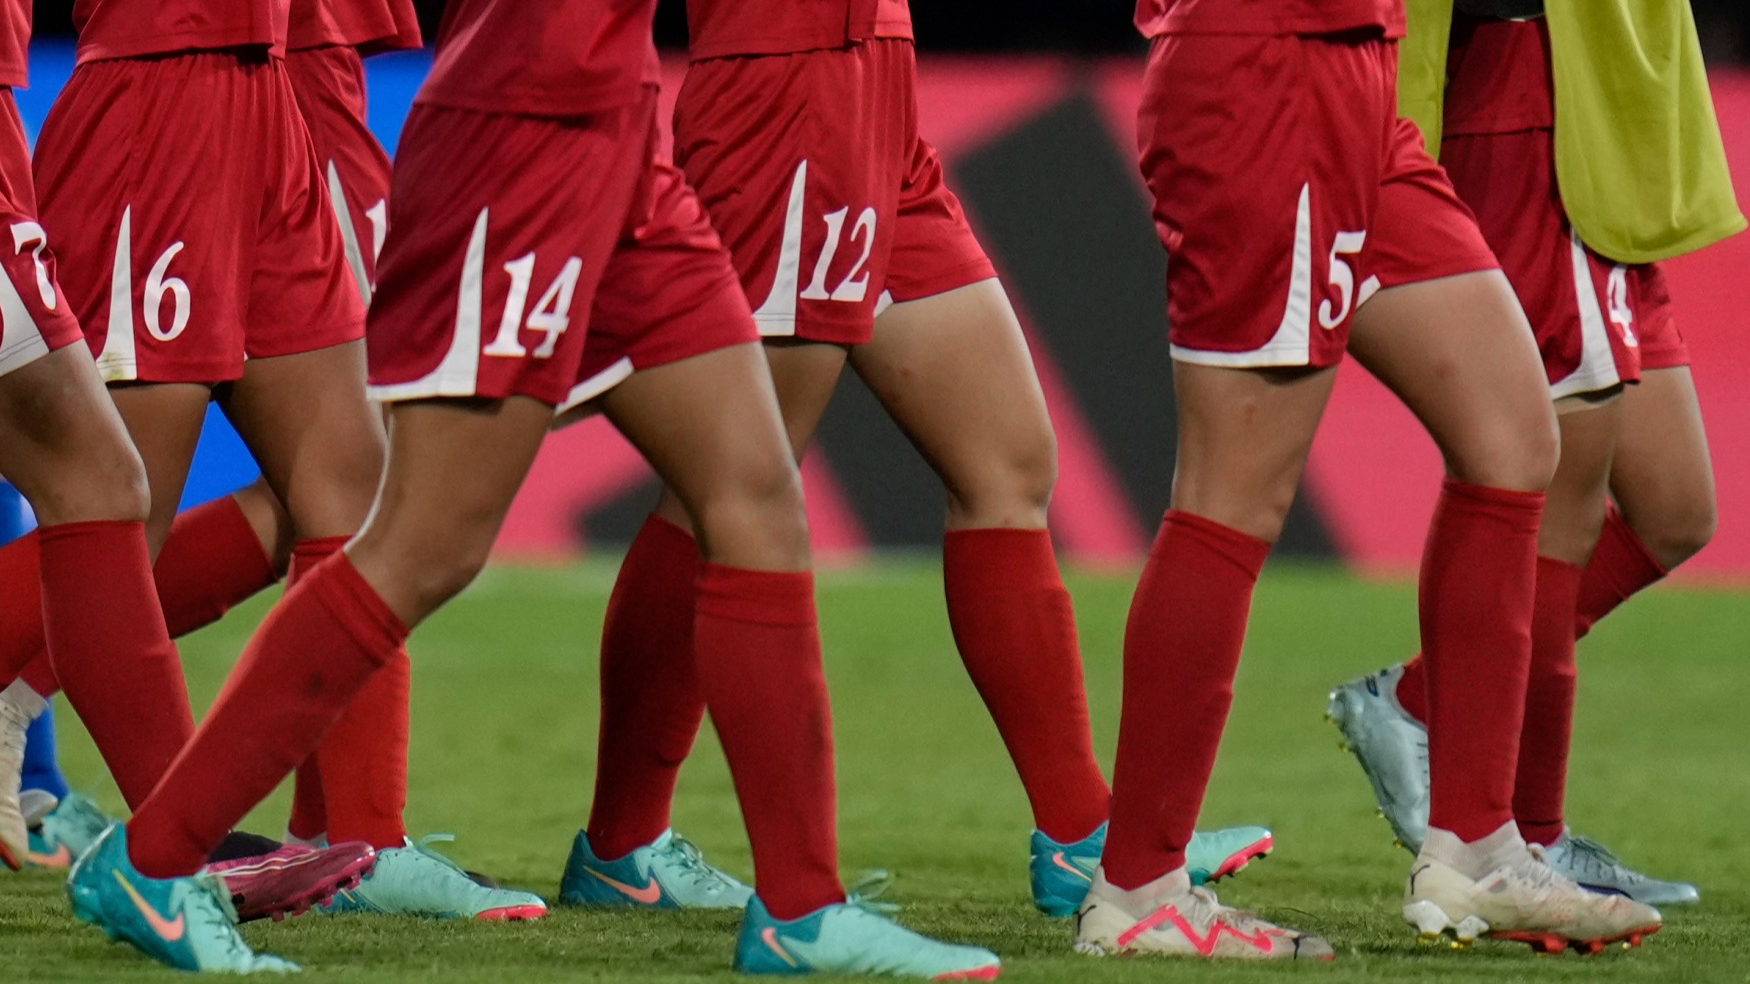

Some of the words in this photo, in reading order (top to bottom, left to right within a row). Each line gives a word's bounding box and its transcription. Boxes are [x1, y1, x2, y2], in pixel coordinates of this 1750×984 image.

[143, 241, 191, 341] 6
[800, 205, 877, 302] 12
[1318, 229, 1367, 330] 5
[483, 251, 583, 359] 14
